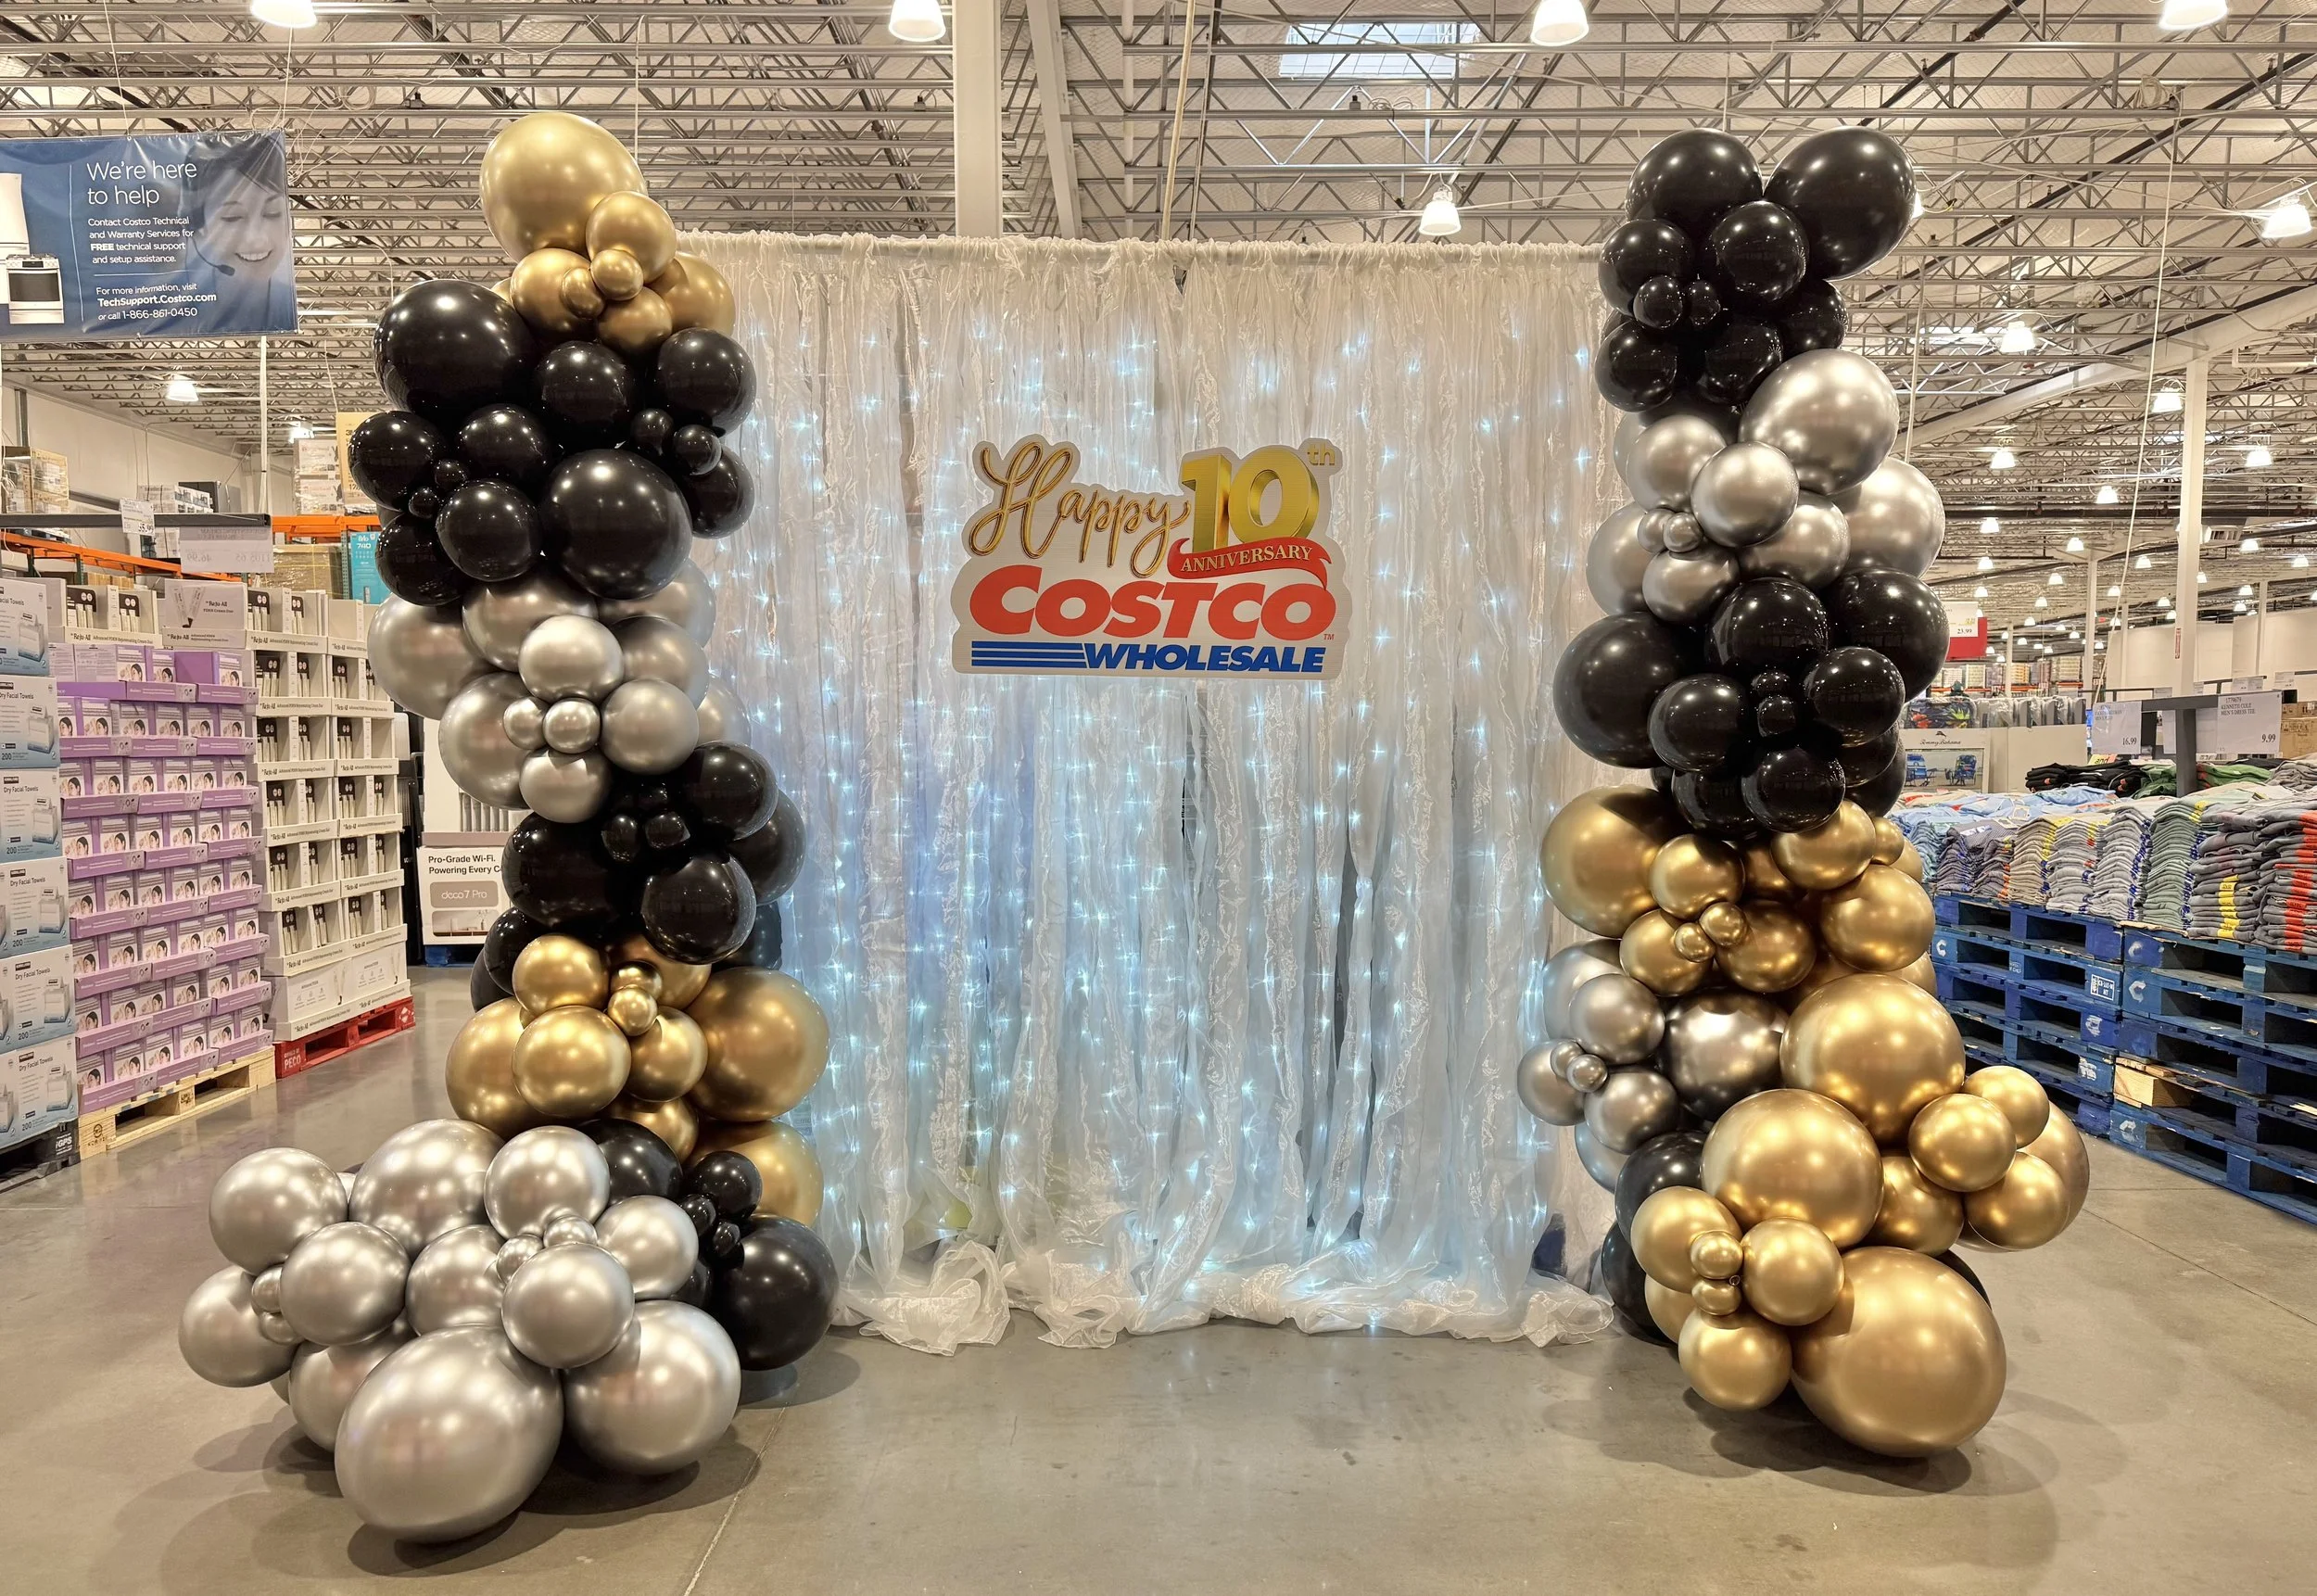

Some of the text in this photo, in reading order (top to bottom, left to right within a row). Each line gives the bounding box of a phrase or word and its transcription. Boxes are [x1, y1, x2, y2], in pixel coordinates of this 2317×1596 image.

[86, 160, 197, 181] We're here
[87, 185, 160, 208] to help
[88, 216, 190, 227] Contact Costco Technical
[89, 229, 195, 240] and Warranty Services for
[91, 242, 186, 251] FREE technical support
[93, 255, 177, 265] and setup assistance.
[134, 284, 181, 295] information,
[182, 283, 197, 291] visit
[97, 293, 217, 308] TechSupport.Costco.com
[108, 311, 121, 321] call
[122, 308, 198, 320] 1-866-861-0450
[969, 441, 1192, 579] Happy
[1180, 545, 1313, 574] ANNIVERSARY
[969, 564, 1336, 640] COSTCO
[1084, 642, 1326, 673] WHOLESALE
[2261, 734, 2276, 743] 9.99
[429, 867, 467, 875] Powering
[468, 866, 492, 874] Every
[472, 890, 487, 899] Pro
[12, 939, 23, 947] 200
[36, 967, 51, 975] Towels
[19, 1031, 29, 1040] 200
[285, 1054, 301, 1070] PECO
[21, 1121, 32, 1132] 200
[56, 1136, 72, 1149] iGPS
